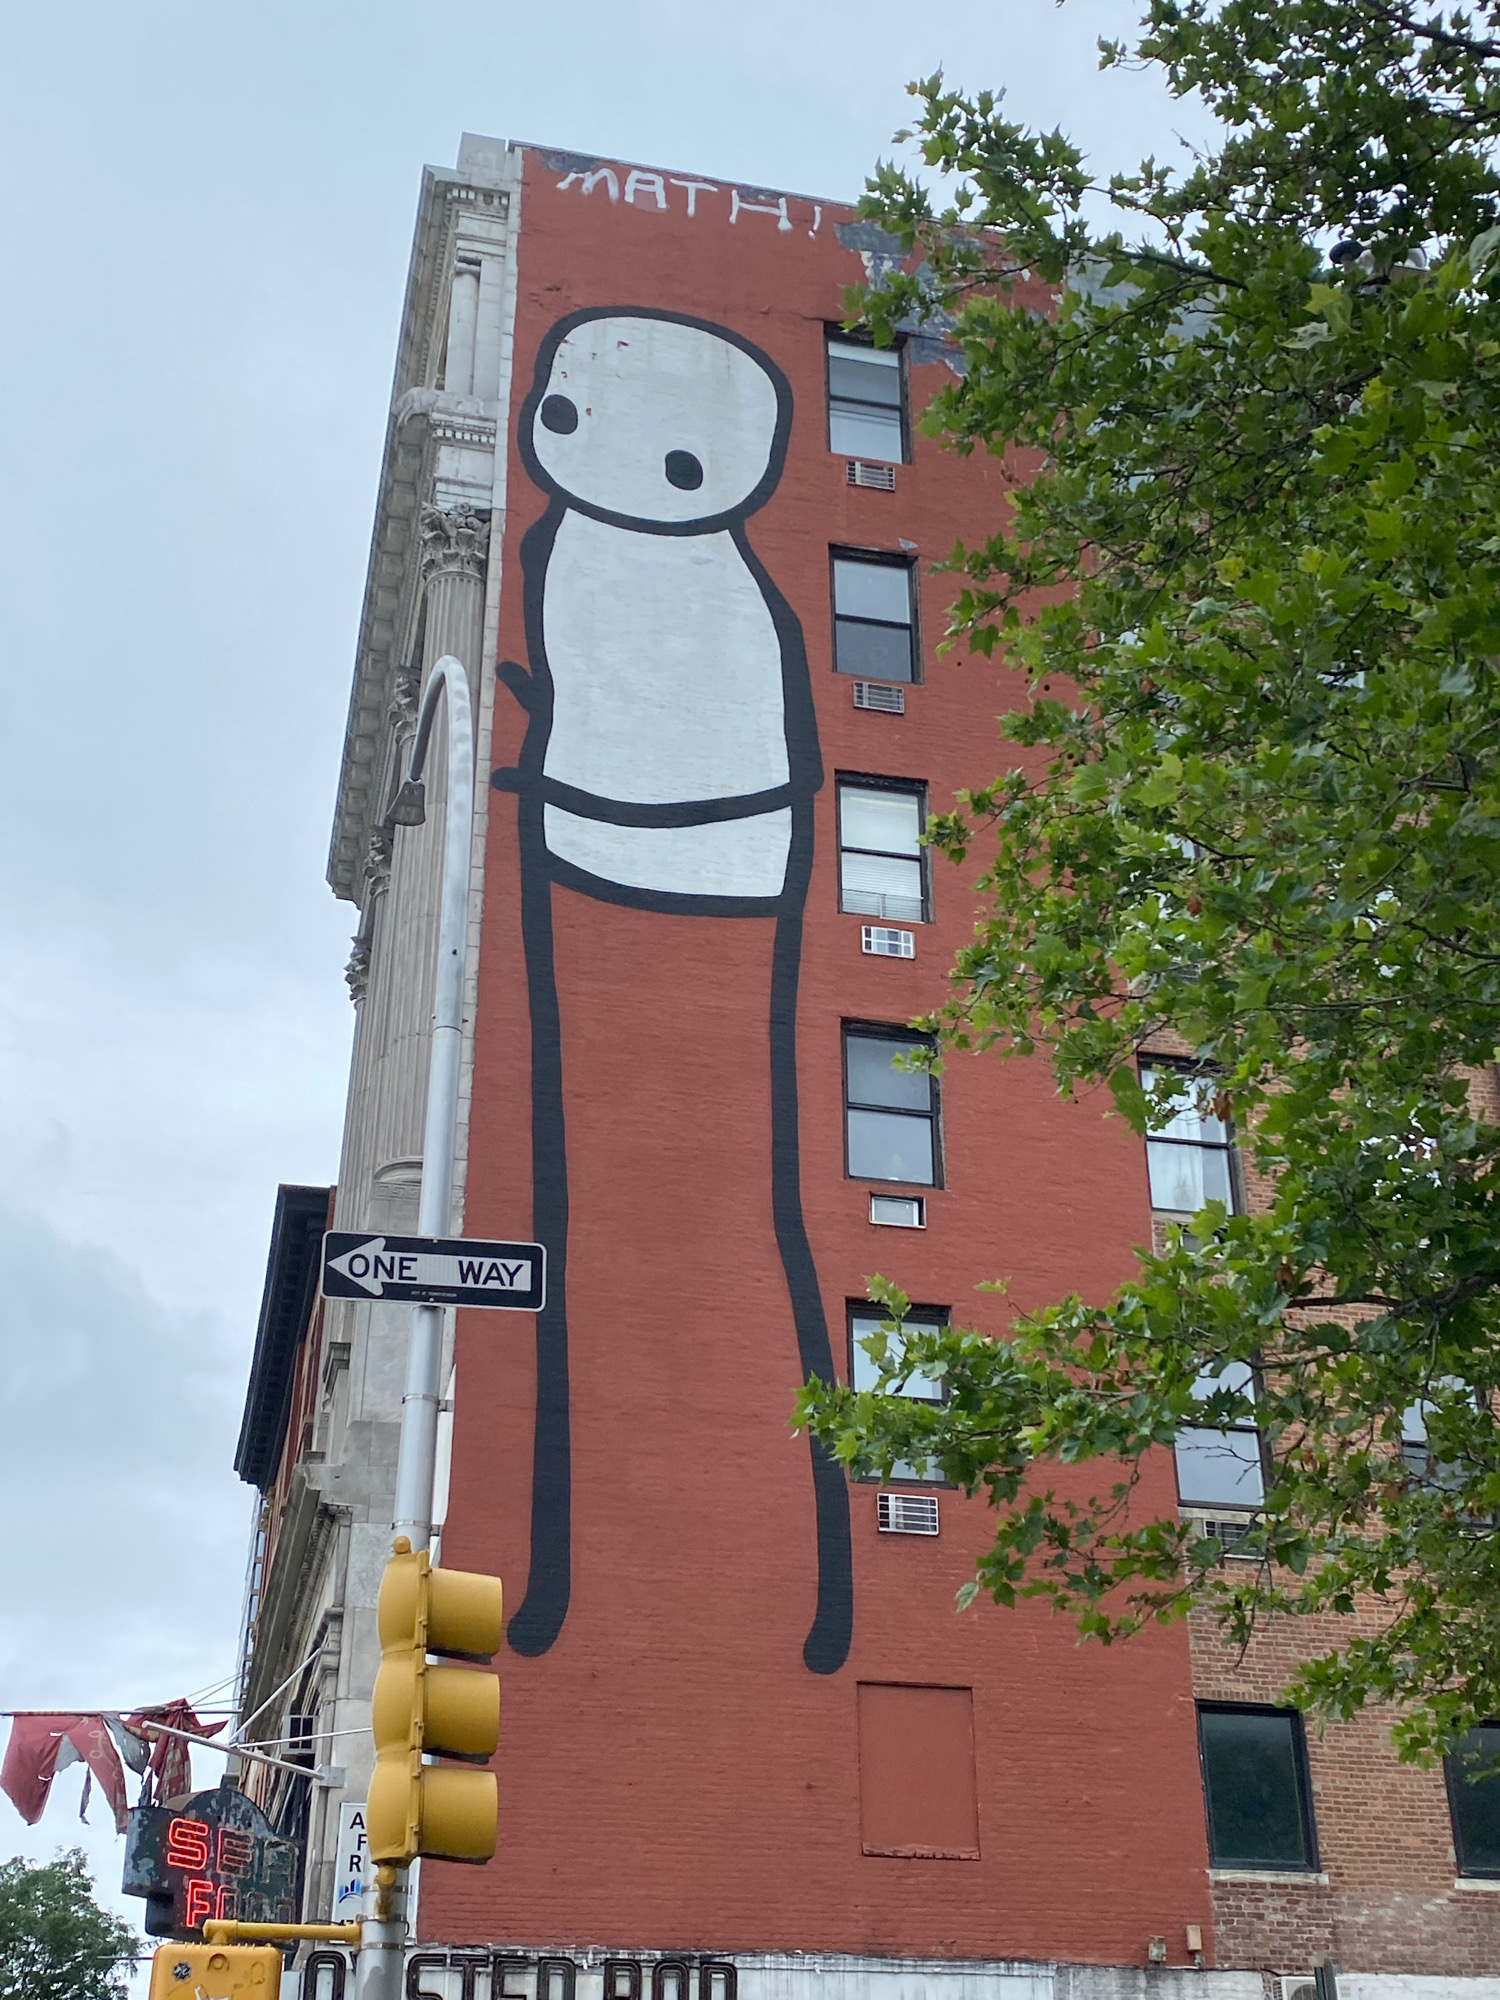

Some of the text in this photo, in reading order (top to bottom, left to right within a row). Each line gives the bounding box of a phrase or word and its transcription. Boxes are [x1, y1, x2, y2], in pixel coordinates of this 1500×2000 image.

[348, 1253, 524, 1287] ONE WAY
[303, 1949, 577, 2000] OSTE
